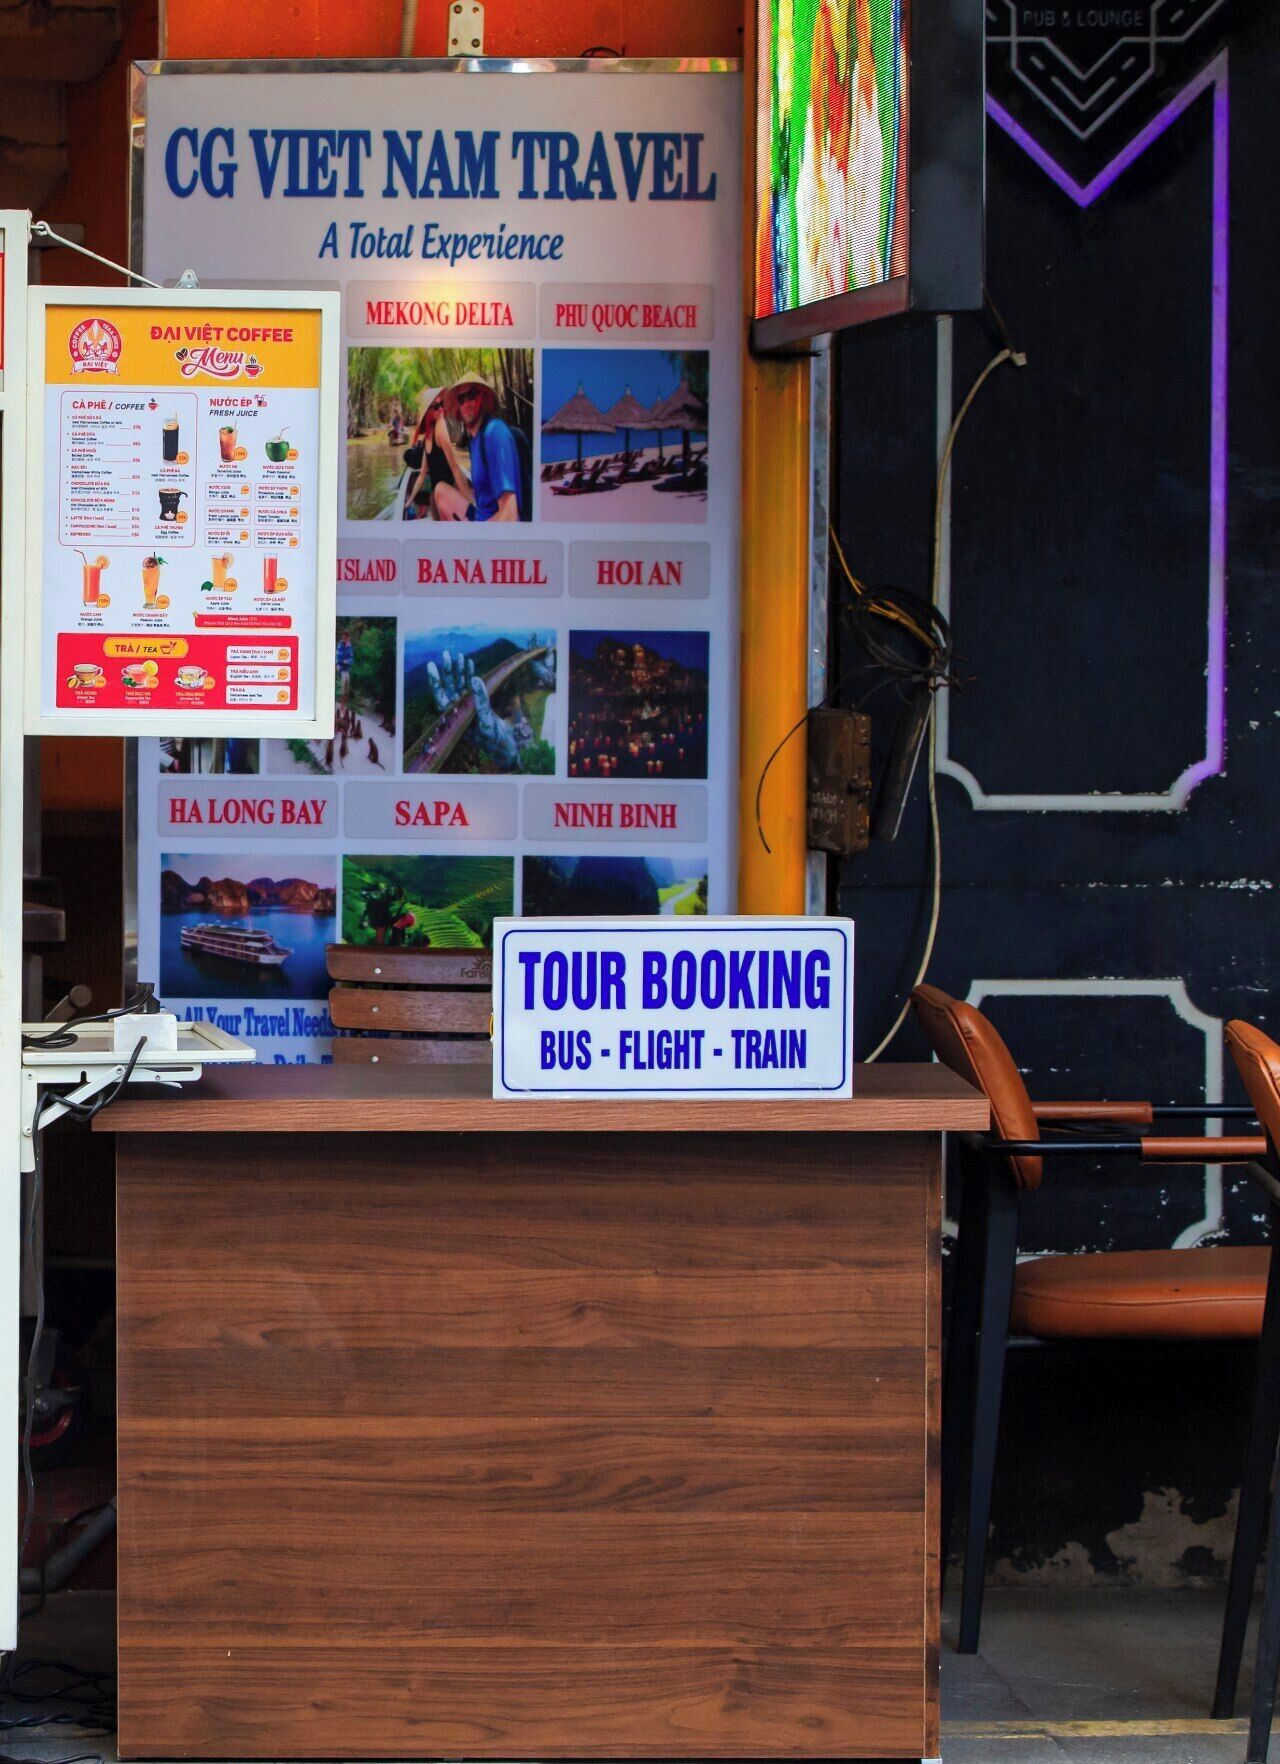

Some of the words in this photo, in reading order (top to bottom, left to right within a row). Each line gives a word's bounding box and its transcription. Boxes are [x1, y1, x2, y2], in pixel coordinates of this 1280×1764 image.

[1023, 10, 1056, 26] PUB
[1077, 10, 1144, 26] LOUNGE
[165, 127, 238, 199] CG
[249, 129, 371, 199] VIET
[383, 130, 500, 199] NAM
[512, 131, 718, 201] TRAVEL
[319, 222, 339, 260] A
[348, 222, 413, 260] Total
[421, 223, 564, 267] Experience
[366, 301, 449, 326] MEKONG
[455, 302, 514, 327] DELTA
[555, 304, 588, 327] PHU
[591, 305, 638, 333] QUOC
[642, 305, 697, 328] BEACH
[72, 324, 86, 349] COFFEE
[150, 326, 181, 344] ĐẠI
[184, 322, 224, 344] VIỆT
[227, 327, 293, 342] COFFEE
[182, 347, 244, 376] Menu
[72, 399, 85, 410] CÀ
[87, 398, 107, 411] PHÊ
[115, 403, 145, 411] COFFEE
[209, 397, 238, 407] NƯỚC
[241, 397, 252, 407] ÉP
[209, 409, 234, 417] FRESH
[336, 559, 396, 582] ISLAND
[417, 558, 451, 583] BA
[453, 559, 485, 583] NA
[491, 559, 547, 584] HILL
[597, 560, 643, 585] HOI
[648, 561, 682, 585] AN
[115, 643, 134, 653] TRÀ
[169, 798, 207, 825] HA
[208, 799, 275, 825] LONG
[280, 800, 326, 825] BAY
[394, 801, 469, 827] SAPA
[554, 803, 614, 828] NINH
[618, 803, 677, 829] BINH
[519, 951, 627, 1010] TOUR
[642, 949, 830, 1009] BOOKING
[244, 1007, 290, 1036] Travel
[541, 1030, 592, 1070] BUS
[620, 1030, 705, 1070] FLIGHT
[731, 1029, 807, 1069] TRAIN
